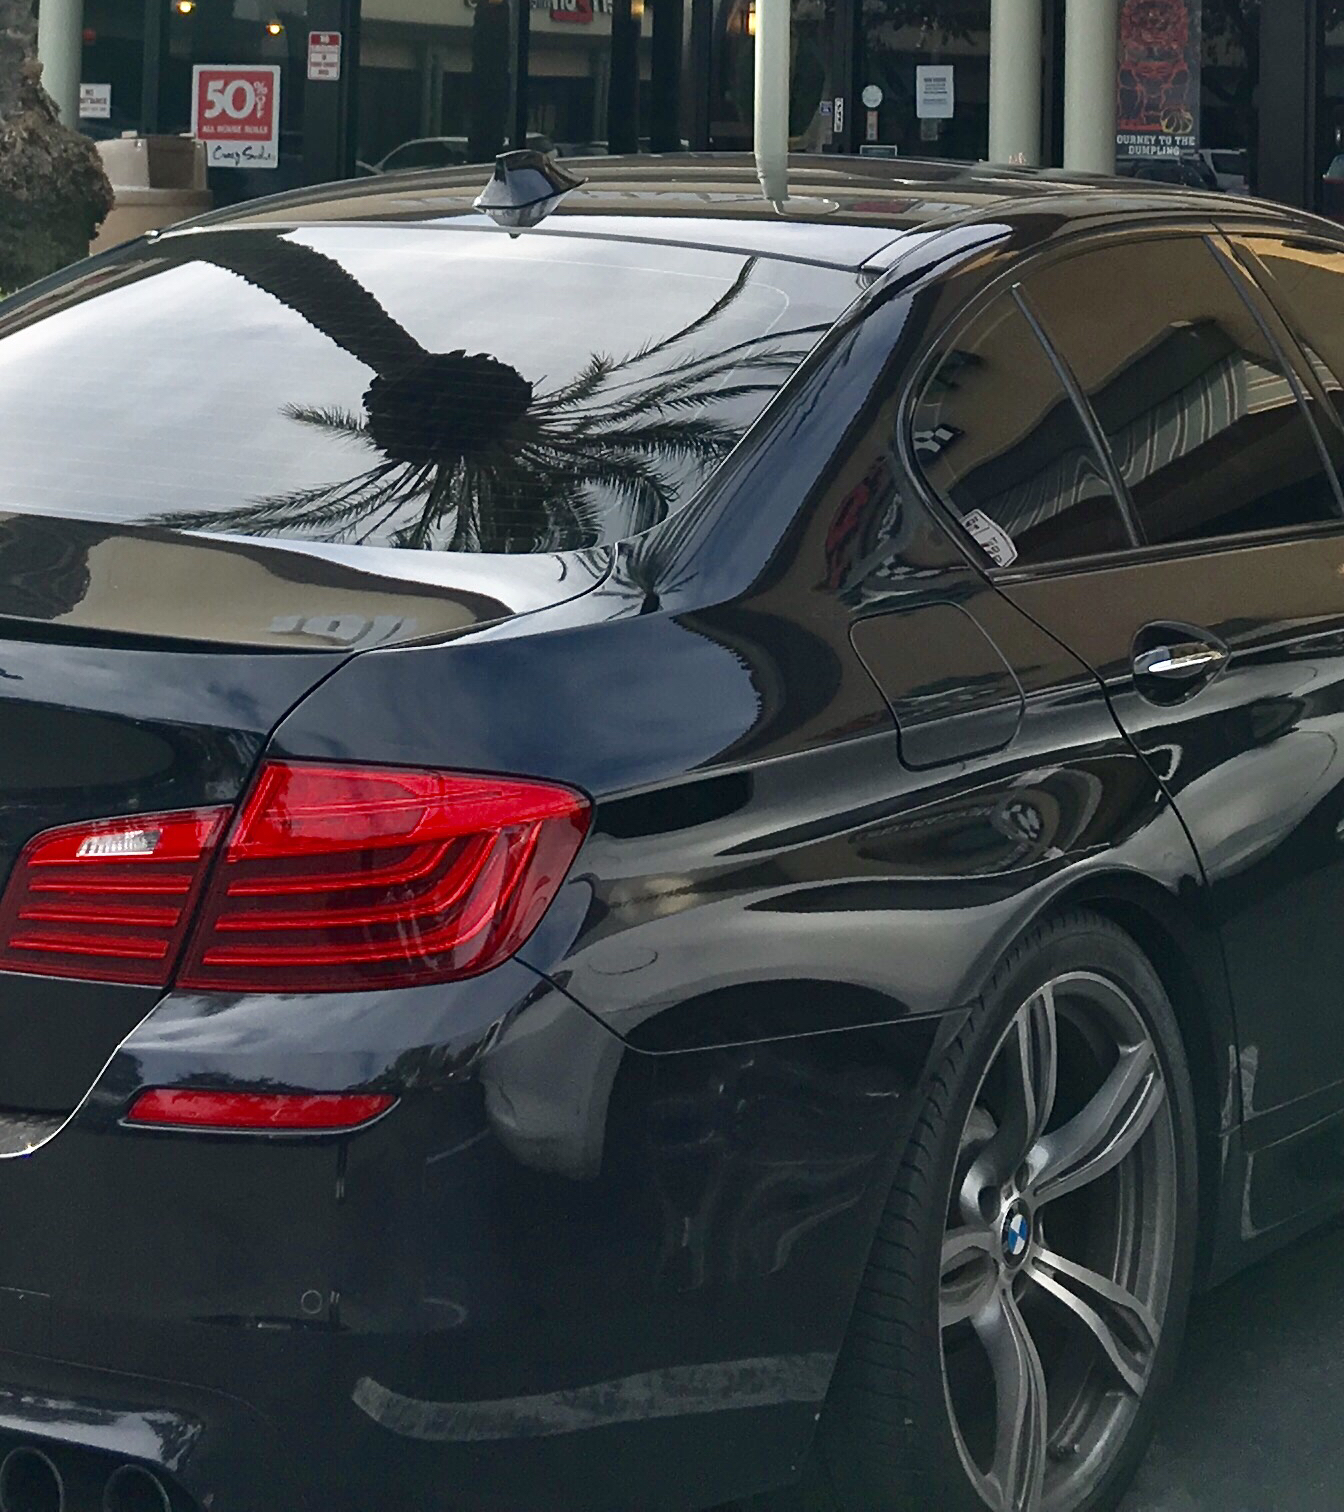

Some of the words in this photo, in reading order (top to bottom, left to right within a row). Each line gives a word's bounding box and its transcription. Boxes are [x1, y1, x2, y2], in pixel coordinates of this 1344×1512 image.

[1116, 135, 1156, 145] OURNEY
[1159, 136, 1172, 145] TO
[1175, 136, 1196, 146] THE
[1128, 145, 1180, 156] DUMPLING
